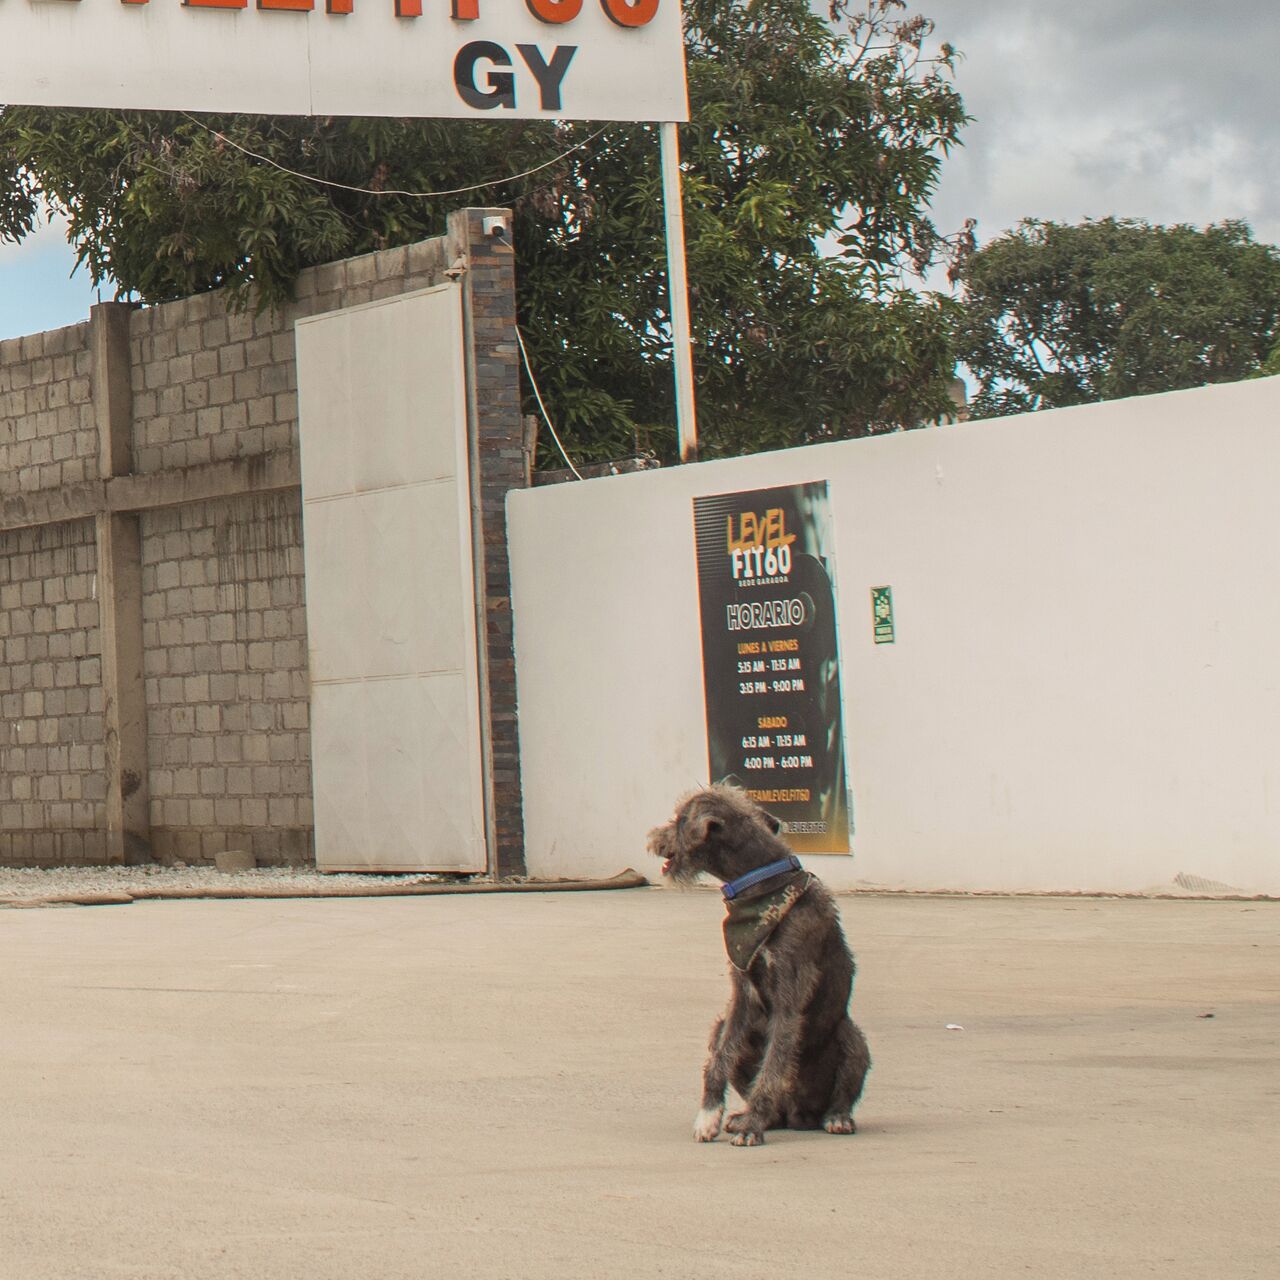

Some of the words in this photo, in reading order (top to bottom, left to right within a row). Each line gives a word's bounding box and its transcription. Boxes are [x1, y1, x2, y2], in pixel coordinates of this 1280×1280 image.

[453, 40, 579, 111] GY
[727, 507, 797, 556] LEVEL
[731, 544, 792, 579] FIT60
[726, 599, 805, 631] HORARIO
[737, 642, 760, 655] LUNES
[761, 641, 768, 653] A
[768, 639, 799, 652] VIERNES
[737, 661, 752, 673] 5:15
[753, 660, 765, 672] AM
[770, 659, 787, 671] 11:15
[787, 658, 801, 670] AM
[740, 682, 754, 694] 3:15
[754, 681, 767, 693] PM
[772, 680, 791, 692] 9:00
[792, 679, 805, 691] PM
[742, 736, 757, 748] 6:15
[758, 736, 770, 748] AM
[776, 735, 792, 747] 11:15
[793, 734, 806, 746] AM
[744, 757, 762, 769] 4:00
[762, 756, 775, 768] PM
[781, 756, 799, 768] 6:00
[800, 755, 813, 767] PM
